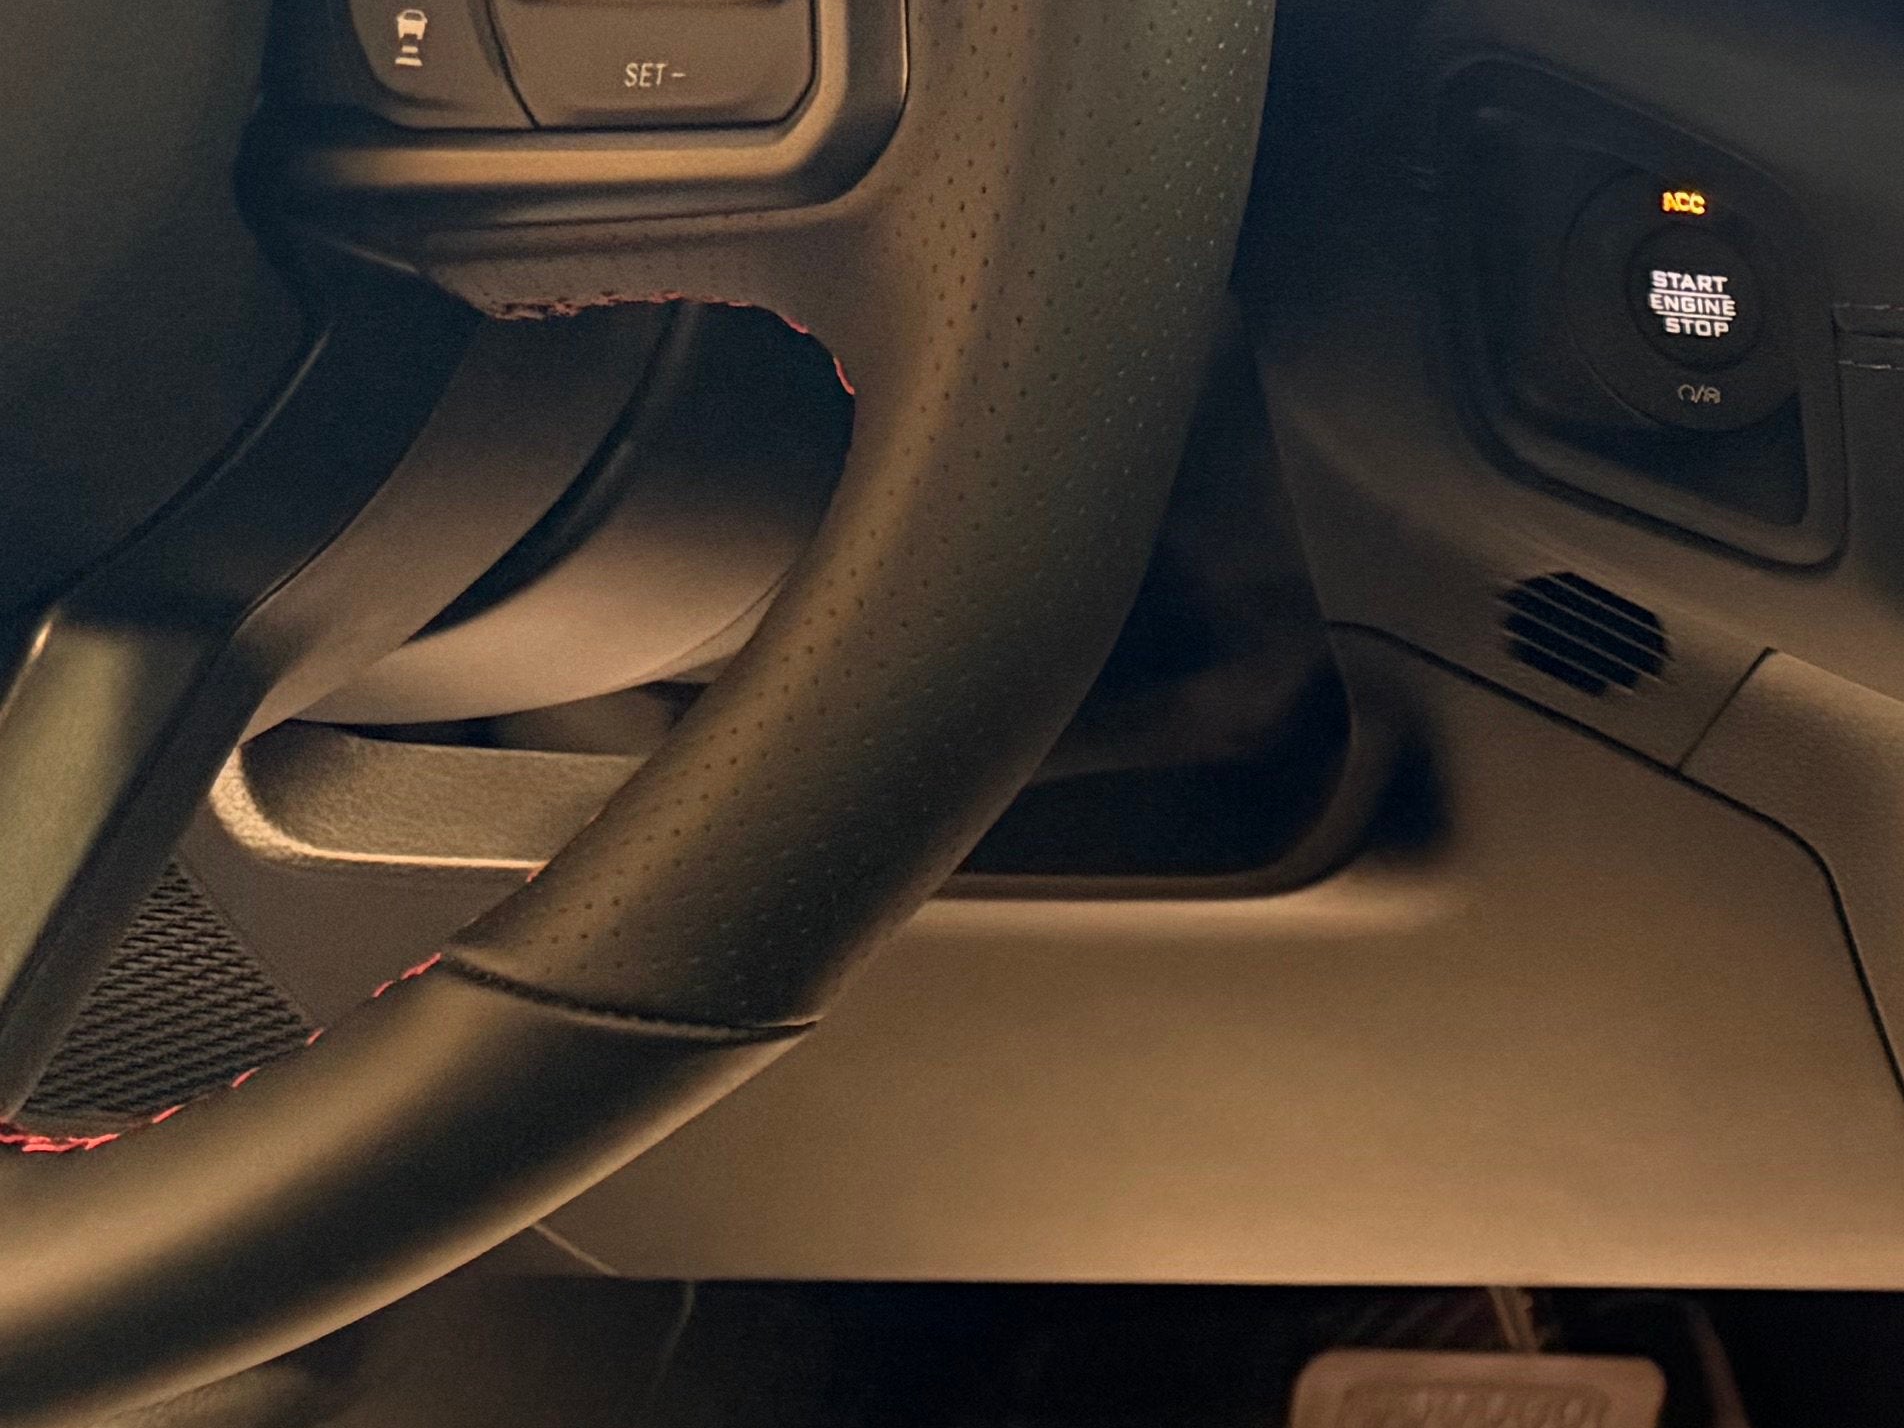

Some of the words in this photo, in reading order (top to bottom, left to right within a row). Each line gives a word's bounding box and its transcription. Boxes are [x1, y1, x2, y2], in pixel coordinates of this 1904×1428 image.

[1662, 191, 1705, 214] ACC
[1652, 270, 1728, 292] START
[1649, 293, 1737, 316] ENGINE
[1665, 318, 1729, 337] STOP
